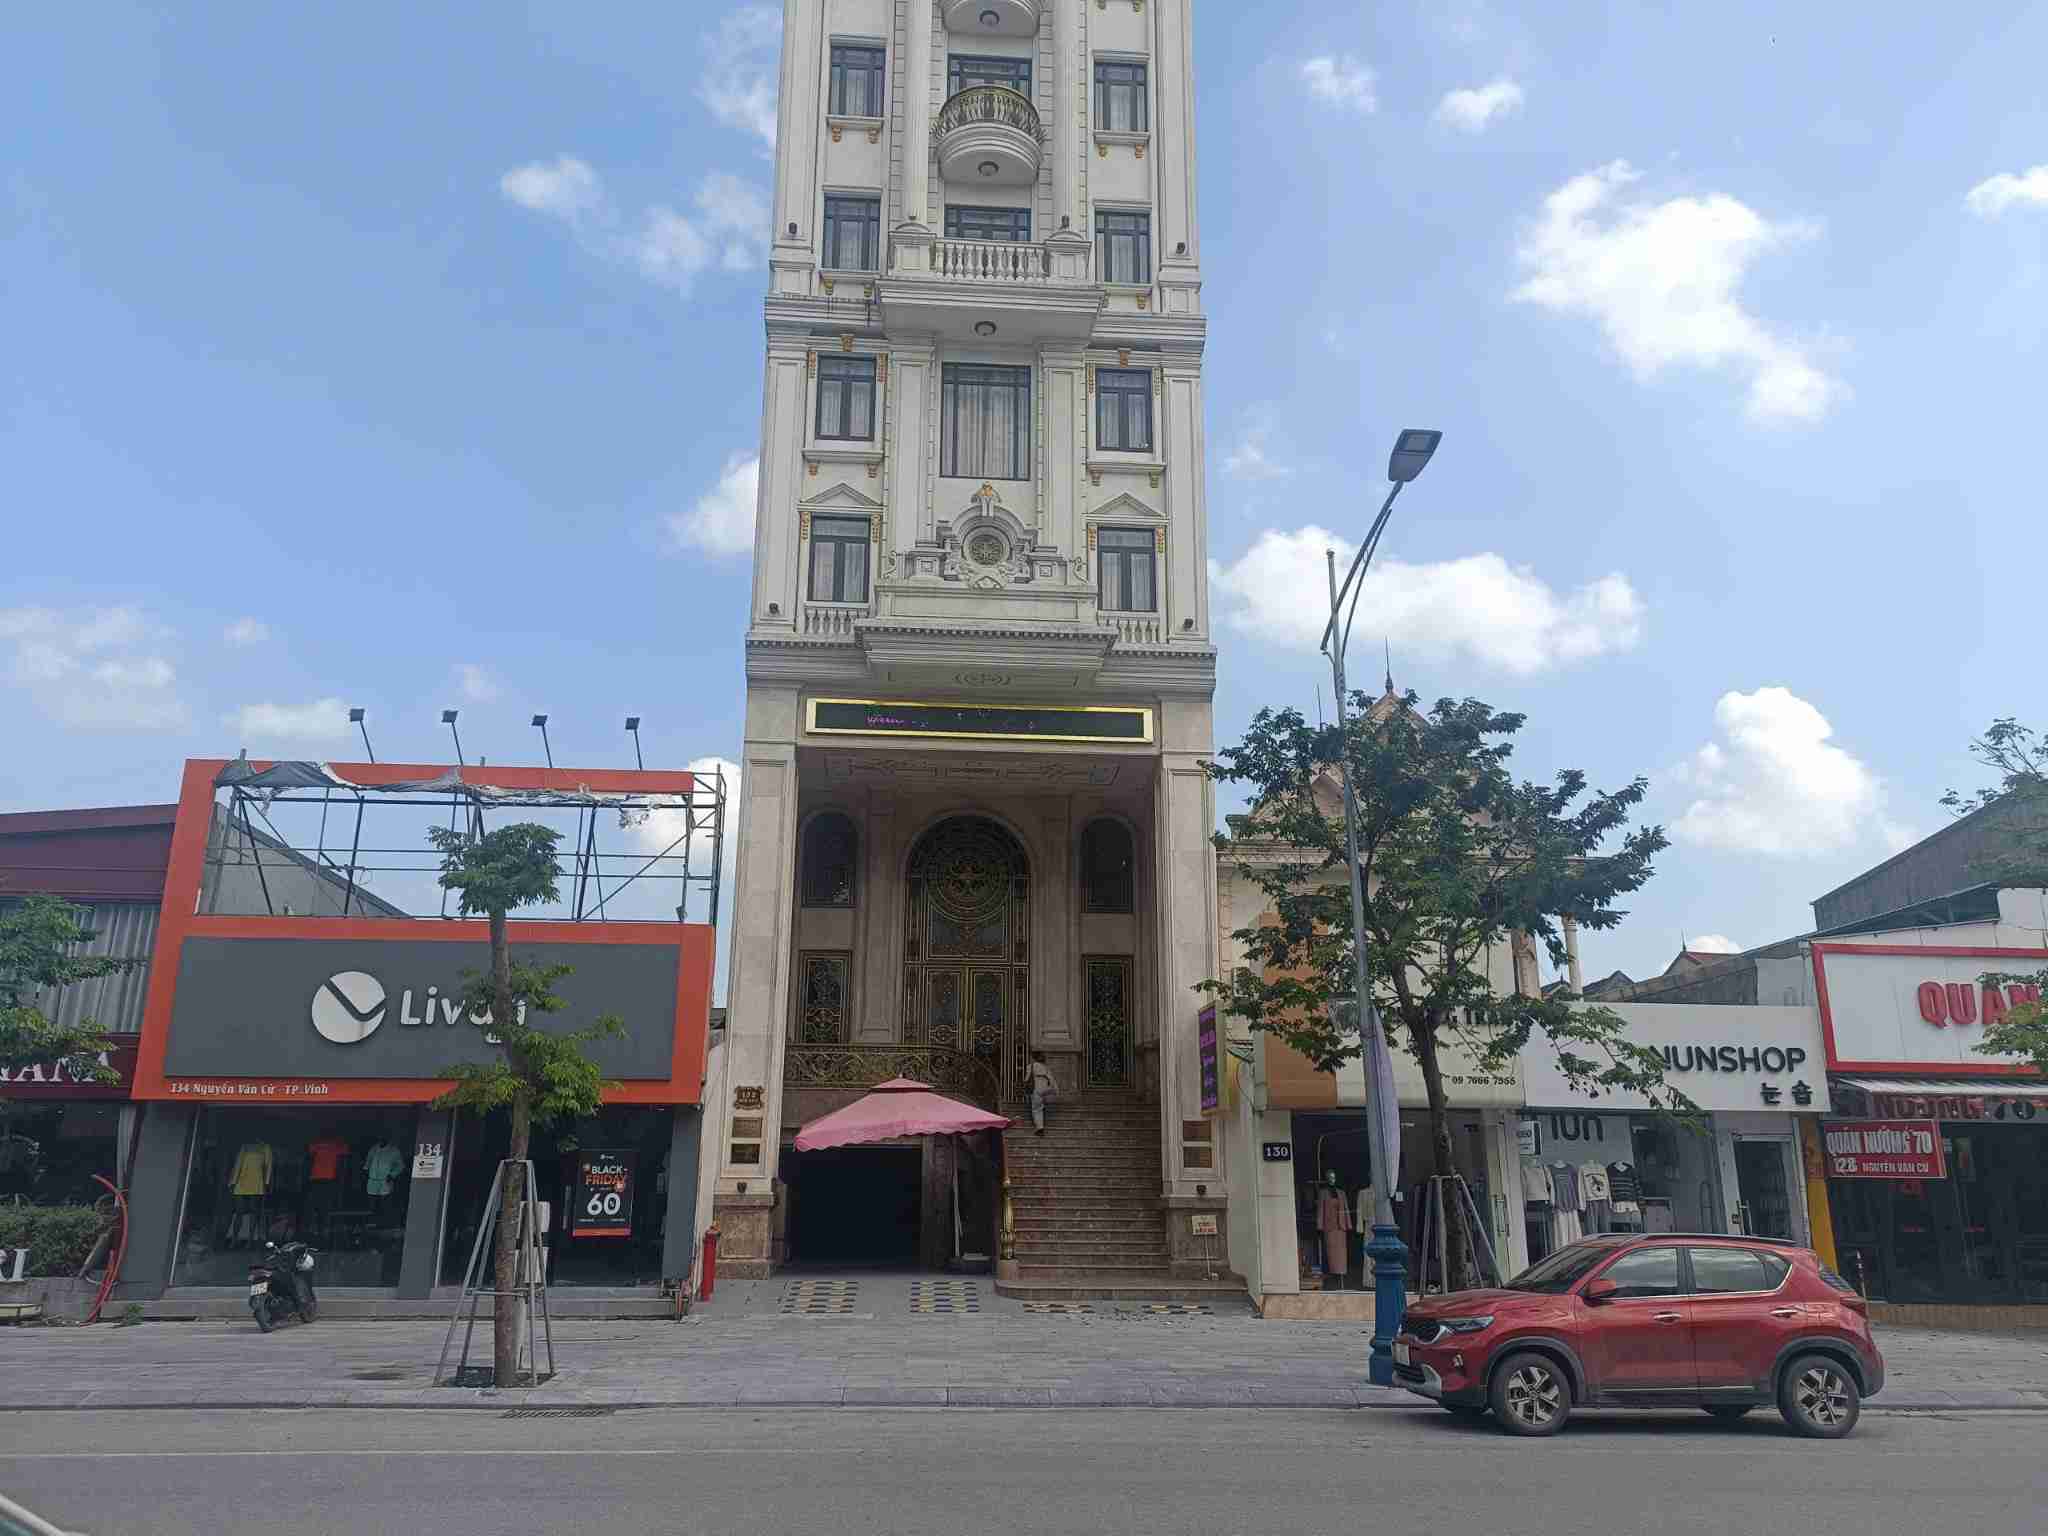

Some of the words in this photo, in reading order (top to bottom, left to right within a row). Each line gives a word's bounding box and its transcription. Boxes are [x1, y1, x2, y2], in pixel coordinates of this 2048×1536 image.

[170, 1082, 190, 1093] 134
[304, 1082, 329, 1094] Vinh
[1265, 1146, 1289, 1157] 130
[592, 1165, 623, 1175] BLACK
[586, 1175, 625, 1185] FRIDAY
